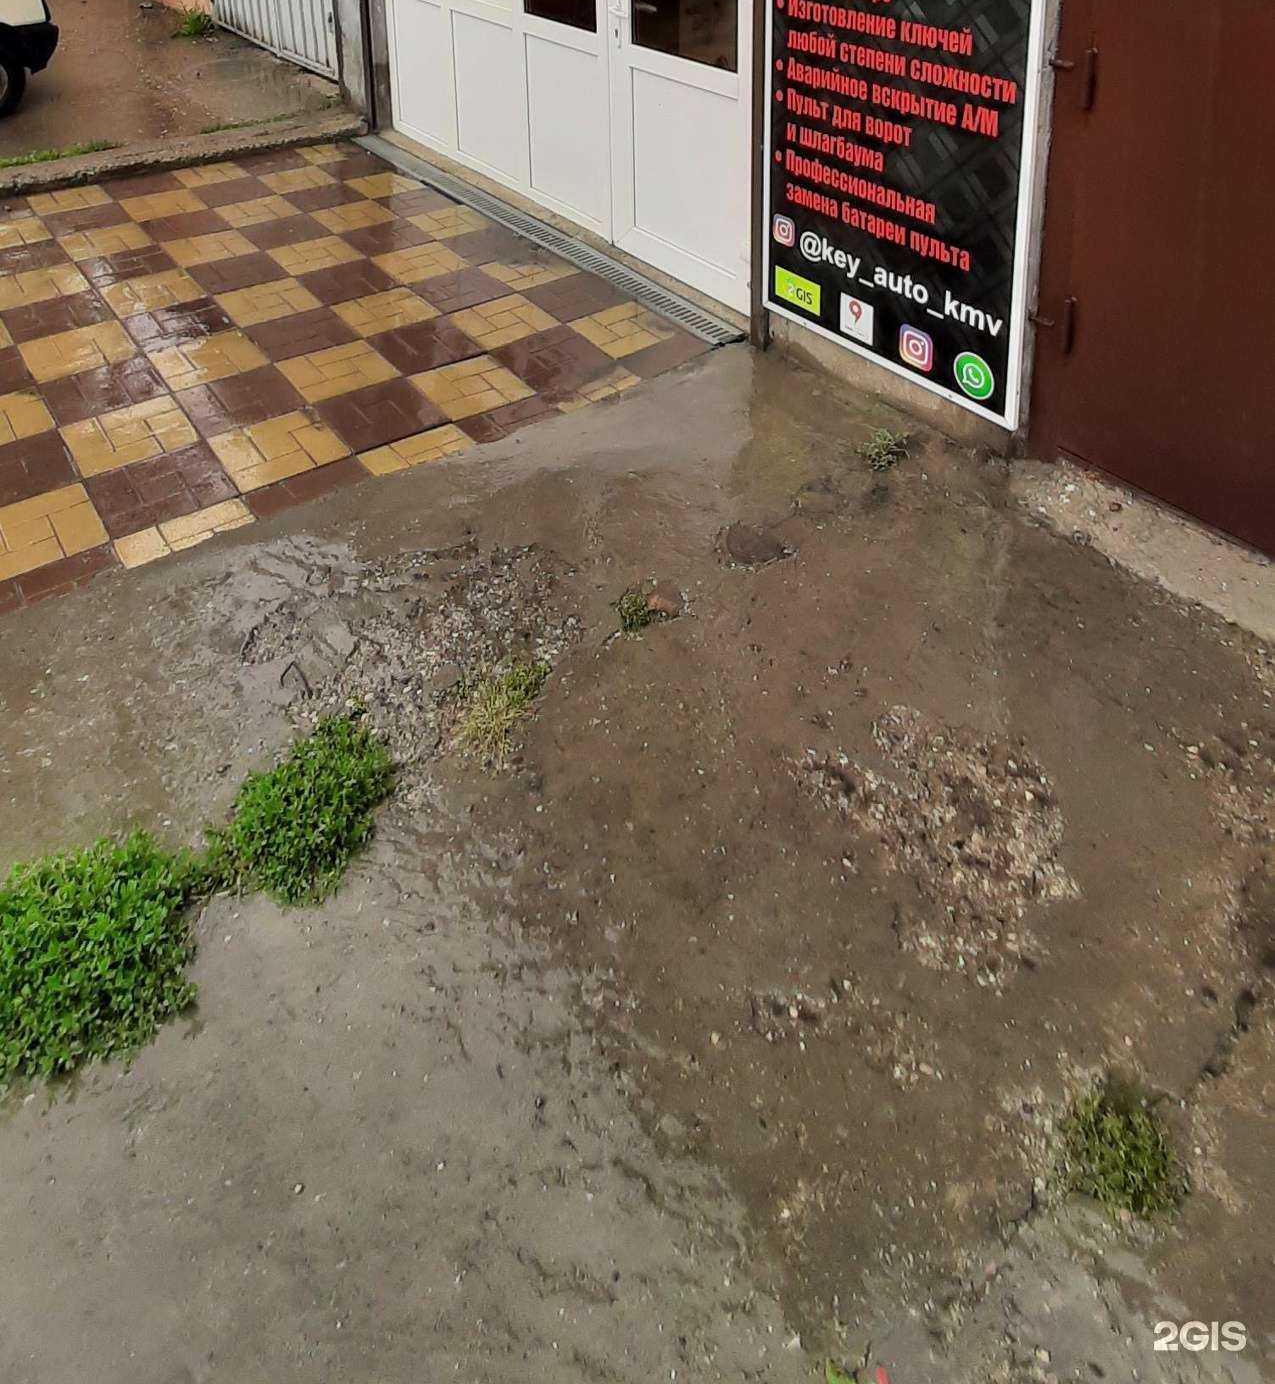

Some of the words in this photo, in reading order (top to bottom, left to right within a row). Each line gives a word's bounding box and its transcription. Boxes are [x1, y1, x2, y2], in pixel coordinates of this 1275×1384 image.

[787, 29, 836, 60] любой
[839, 41, 907, 77] степени
[910, 58, 1018, 105] сложности
[900, 19, 973, 56] ключей
[787, 56, 868, 102] Аварийное
[872, 83, 958, 126] вскрытие
[961, 103, 999, 138] А/М
[787, 87, 829, 121] Пульт
[831, 105, 862, 132] для
[865, 116, 913, 147] ворот
[786, 122, 797, 143] и
[800, 126, 885, 173] шлагбаума
[786, 148, 936, 225] Профессиональная
[786, 181, 839, 219] замена
[841, 200, 907, 246] батареи
[909, 229, 971, 272] пульта
[800, 230, 1004, 337] @key_auto_kmv
